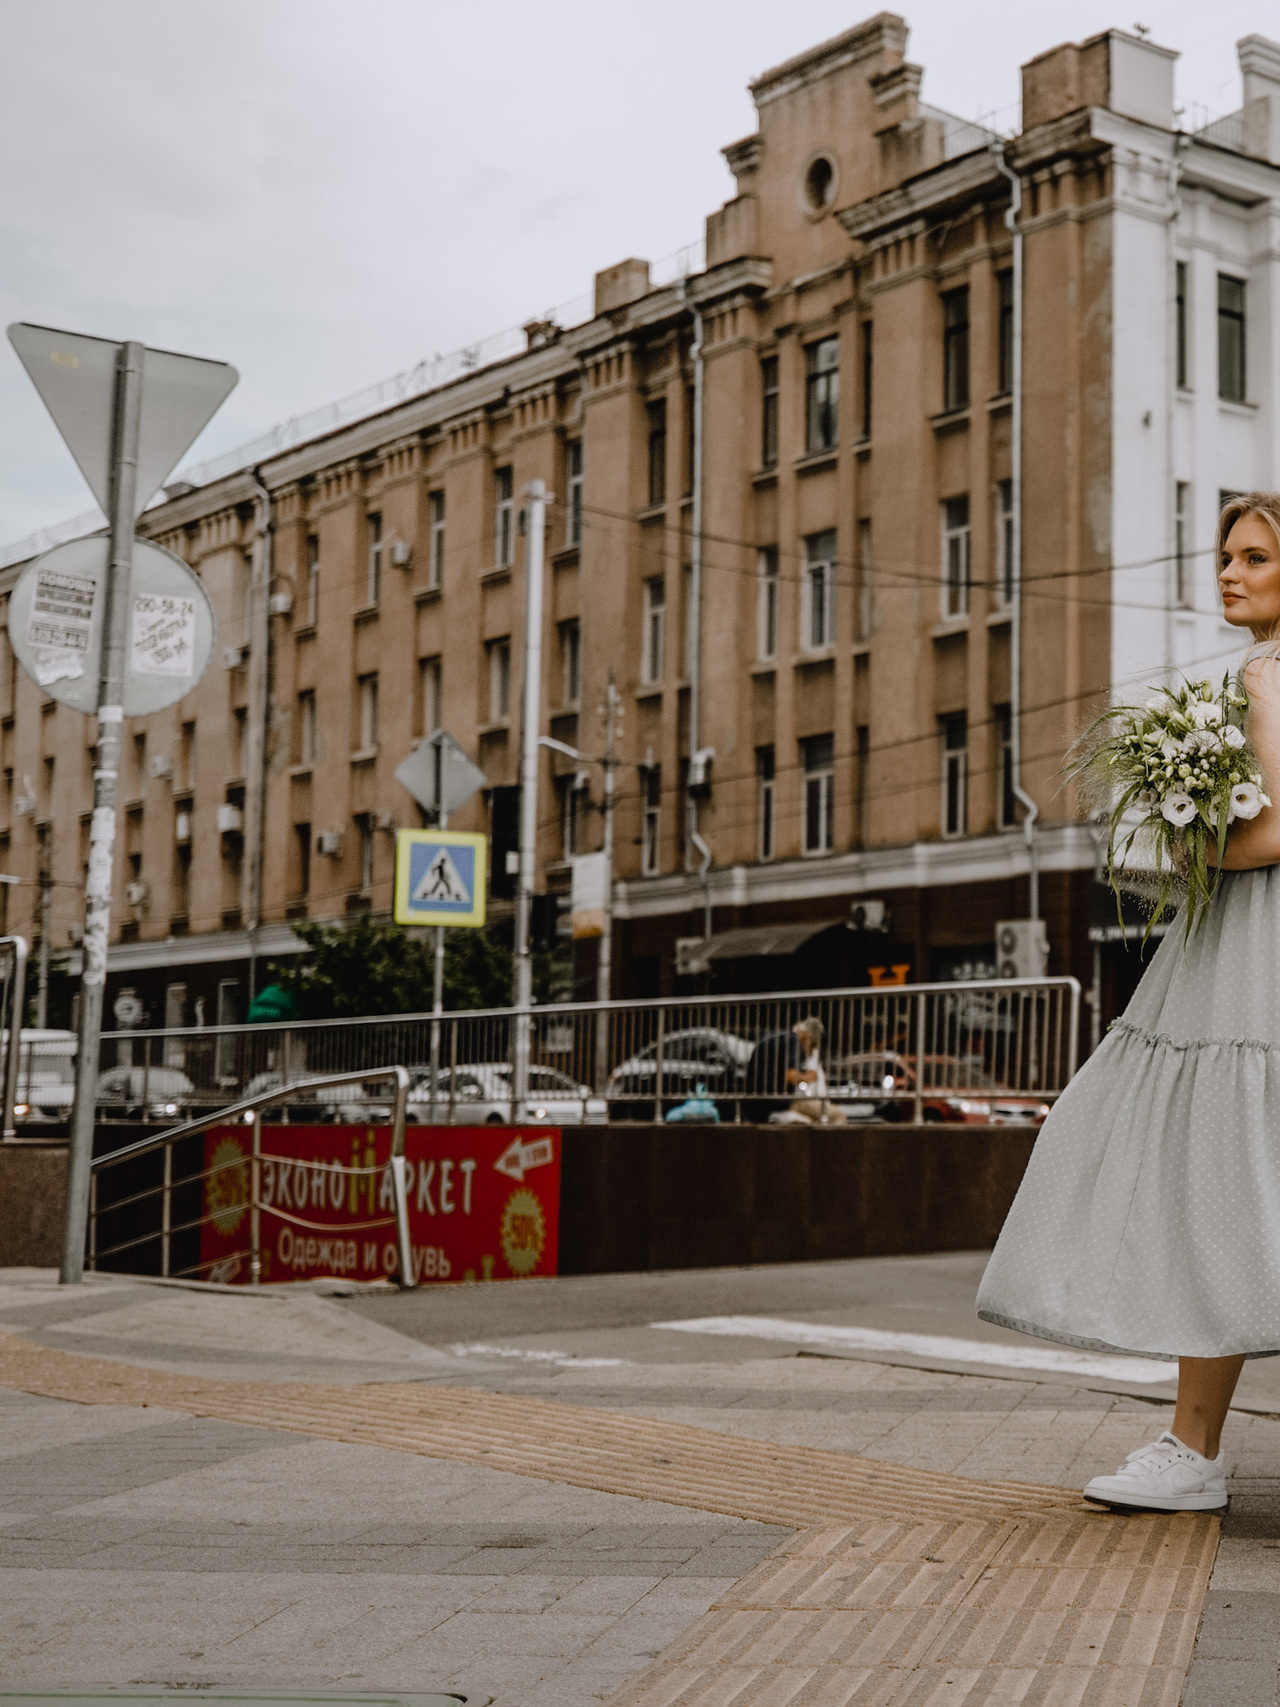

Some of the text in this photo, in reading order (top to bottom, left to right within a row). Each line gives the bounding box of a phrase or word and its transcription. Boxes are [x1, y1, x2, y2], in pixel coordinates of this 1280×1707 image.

[278, 1226, 357, 1274] Одежда
[363, 1241, 377, 1272] и
[383, 1243, 451, 1282] оувь
